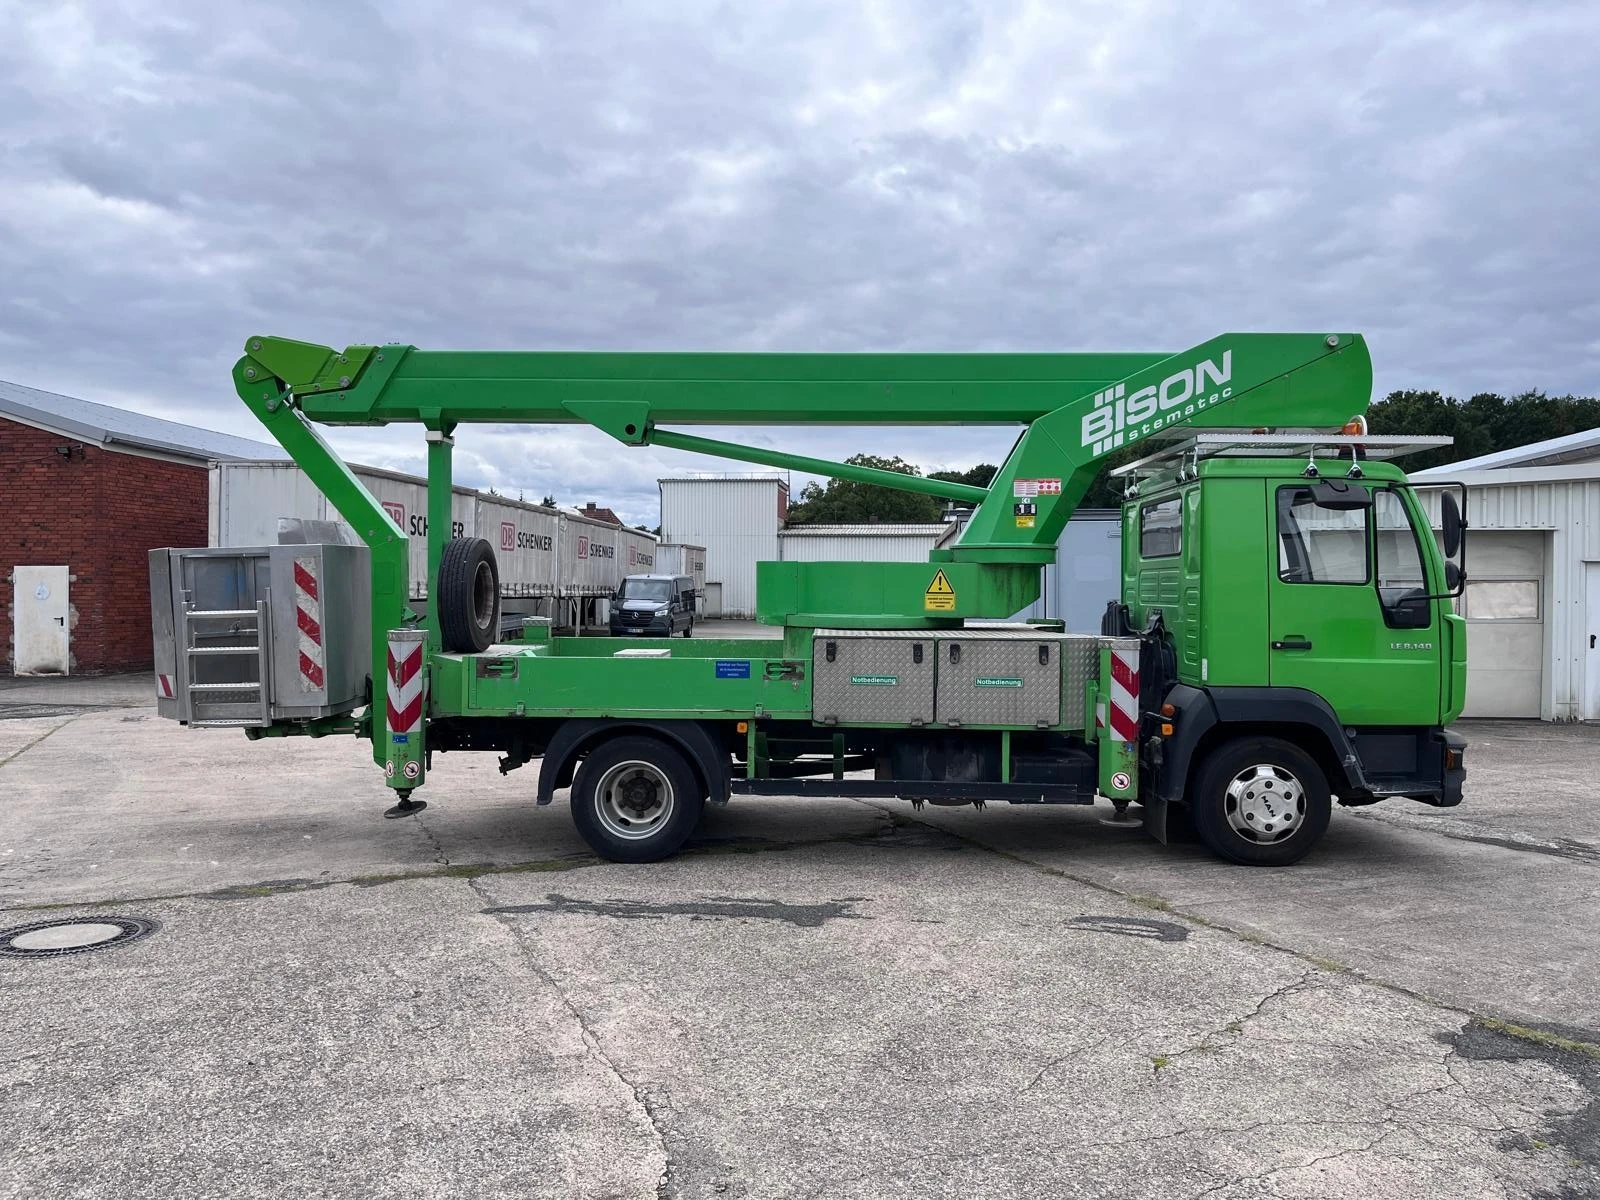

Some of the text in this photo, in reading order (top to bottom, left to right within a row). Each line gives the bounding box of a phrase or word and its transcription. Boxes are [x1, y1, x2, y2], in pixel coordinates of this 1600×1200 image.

[1128, 387, 1232, 440] stematec
[410, 514, 464, 538] SCHER
[502, 525, 552, 551] DB SCHENKER
[852, 677, 896, 685] Notbedienung
[977, 679, 1022, 687] Notbedienung
[1261, 795, 1277, 818] MAN
